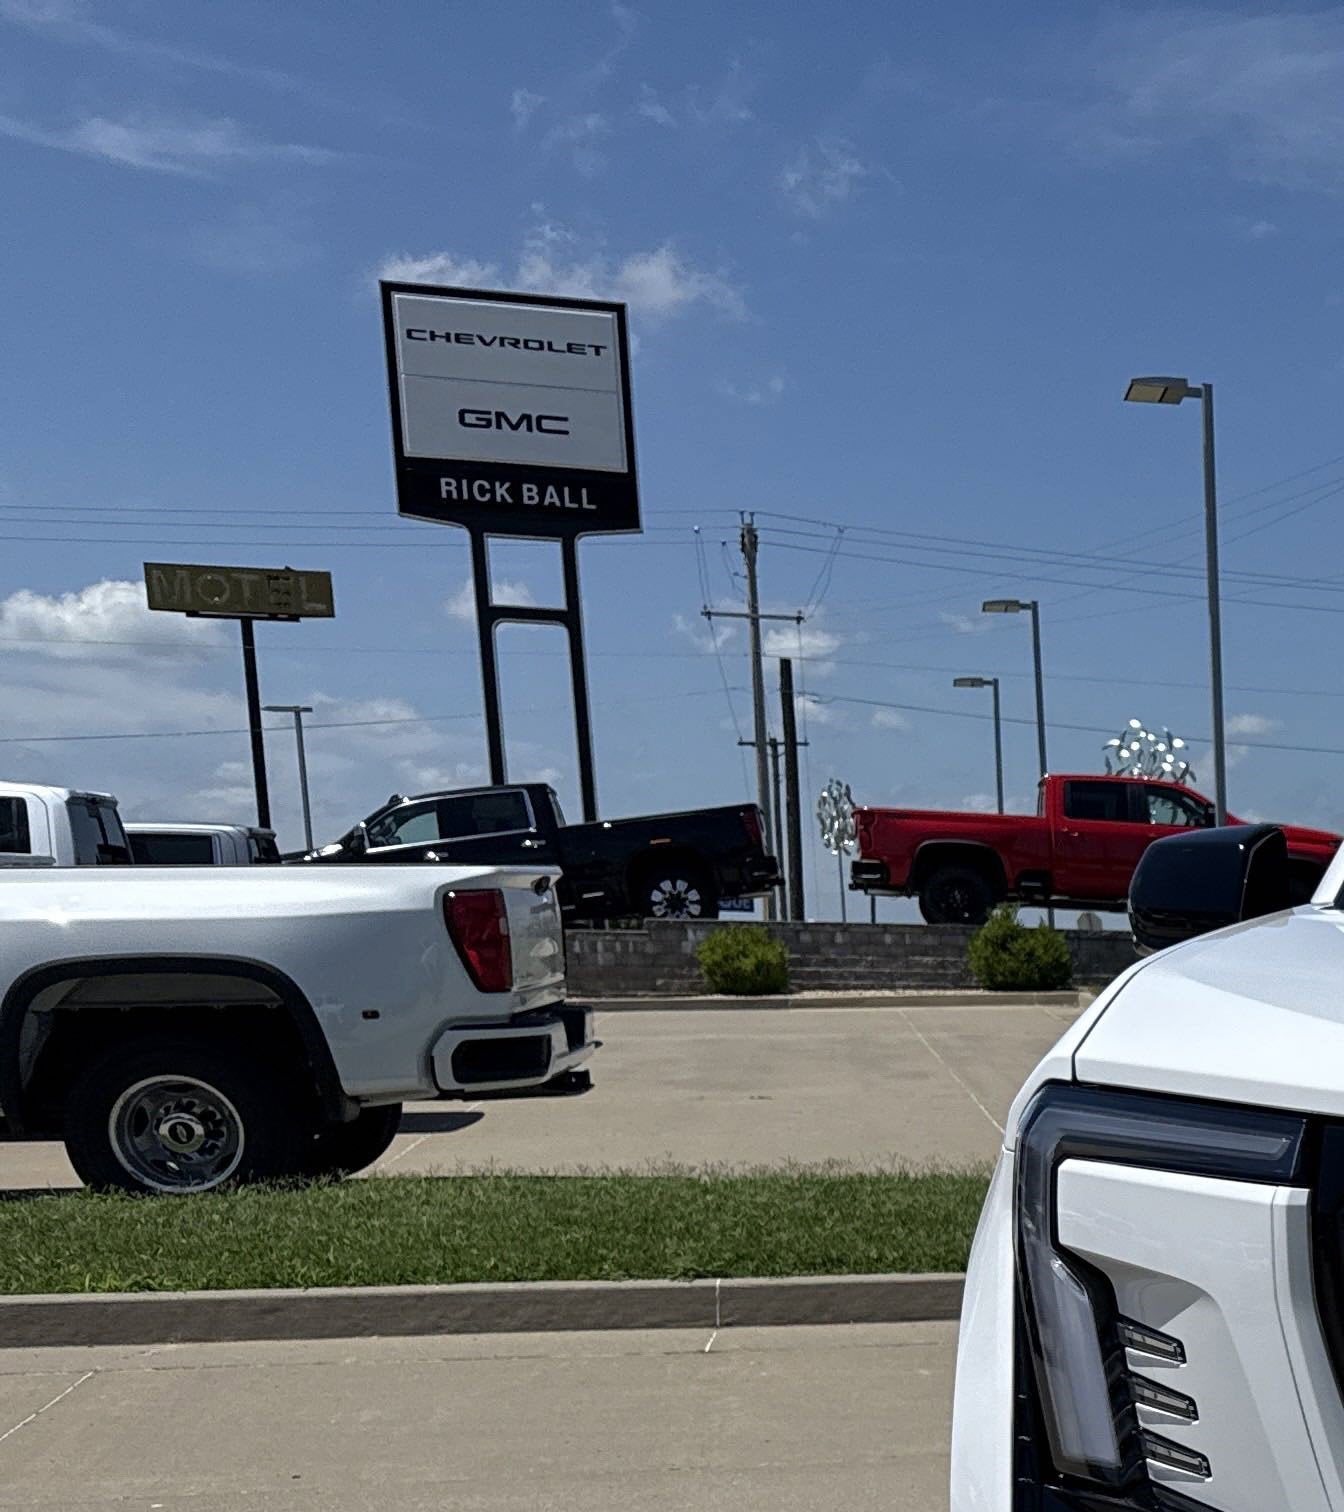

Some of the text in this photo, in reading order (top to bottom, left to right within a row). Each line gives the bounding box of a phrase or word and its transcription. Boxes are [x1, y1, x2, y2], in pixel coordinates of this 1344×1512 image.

[405, 327, 608, 357] CHEVROLET
[457, 407, 570, 437] GMC
[440, 477, 597, 510] RICK BALL
[151, 569, 327, 611] MOTEL
